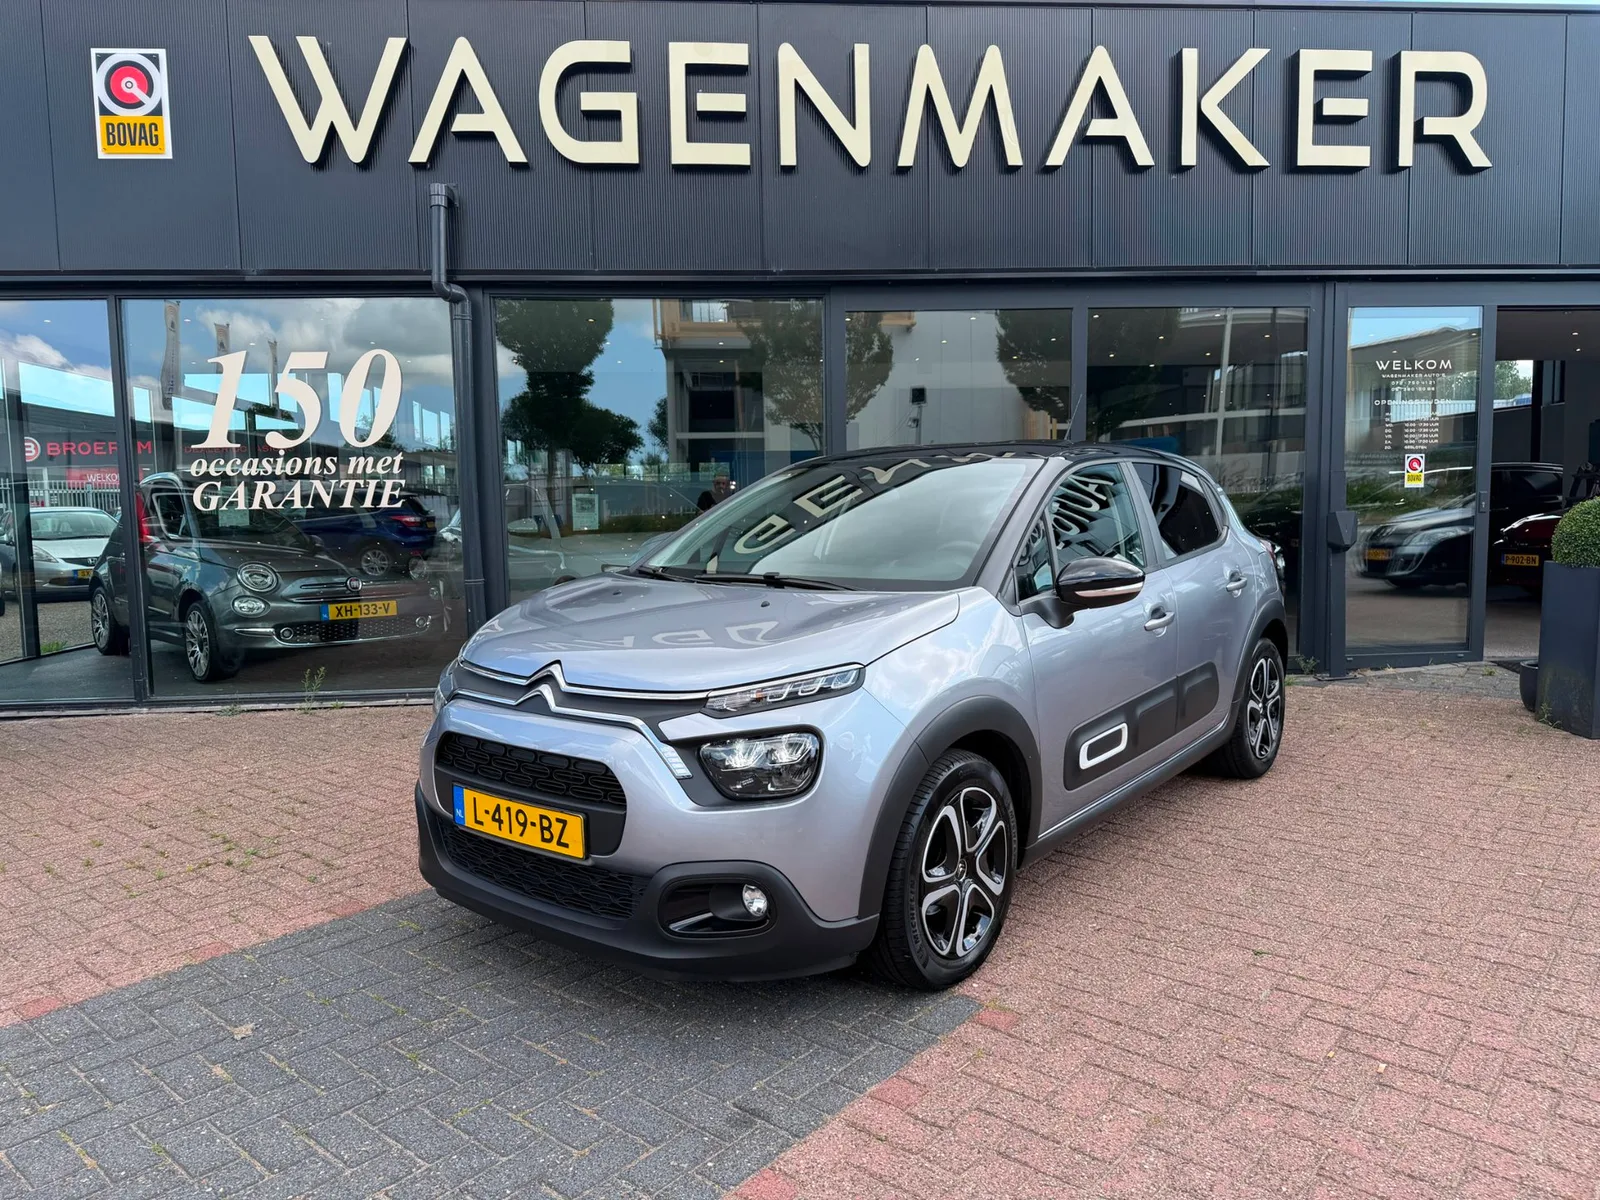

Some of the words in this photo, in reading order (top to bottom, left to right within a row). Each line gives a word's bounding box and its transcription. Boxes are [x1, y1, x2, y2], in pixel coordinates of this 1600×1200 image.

[248, 35, 1492, 168] WAGENMAKER
[105, 122, 159, 147] BOVAG
[1375, 359, 1452, 371] WELKOM
[191, 349, 403, 449] 150
[190, 450, 337, 477] occasions
[348, 451, 404, 475] met
[86, 473, 119, 482] WELKO
[192, 479, 405, 511] GARANTIE
[1505, 555, 1537, 565] P-902-BN
[335, 603, 390, 618] XH-133-V
[456, 809, 464, 819] NL
[473, 797, 570, 849] L-419-BZ
